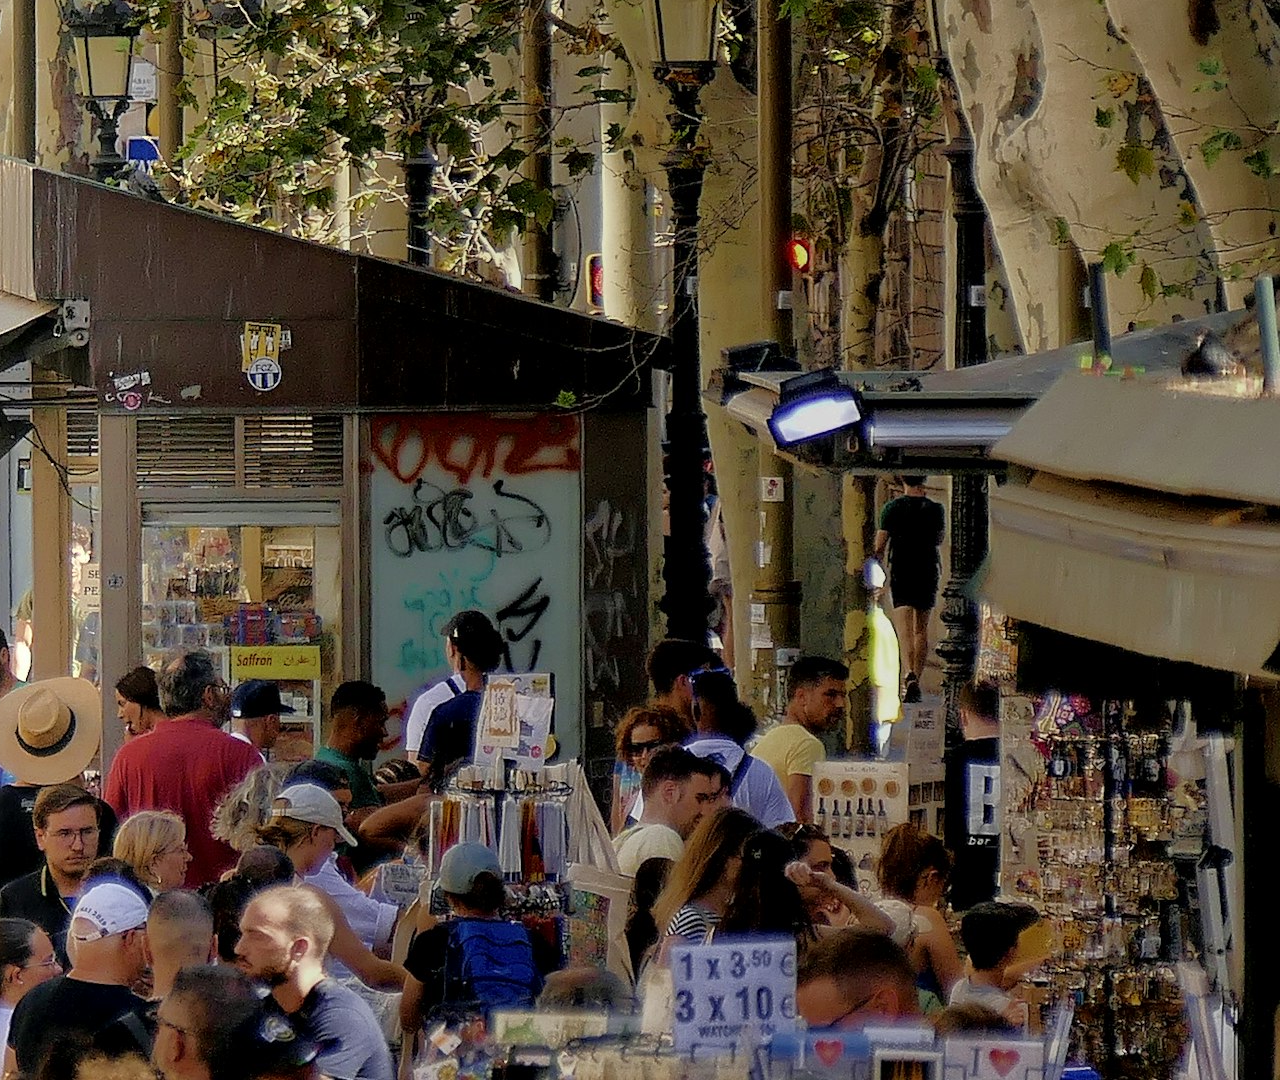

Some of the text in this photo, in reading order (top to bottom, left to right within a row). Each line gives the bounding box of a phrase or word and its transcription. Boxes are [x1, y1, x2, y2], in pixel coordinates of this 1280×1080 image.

[255, 364, 273, 372] FCZ
[236, 654, 273, 667] Saffron
[676, 989, 695, 1023] 3
[736, 985, 773, 1021] 10
